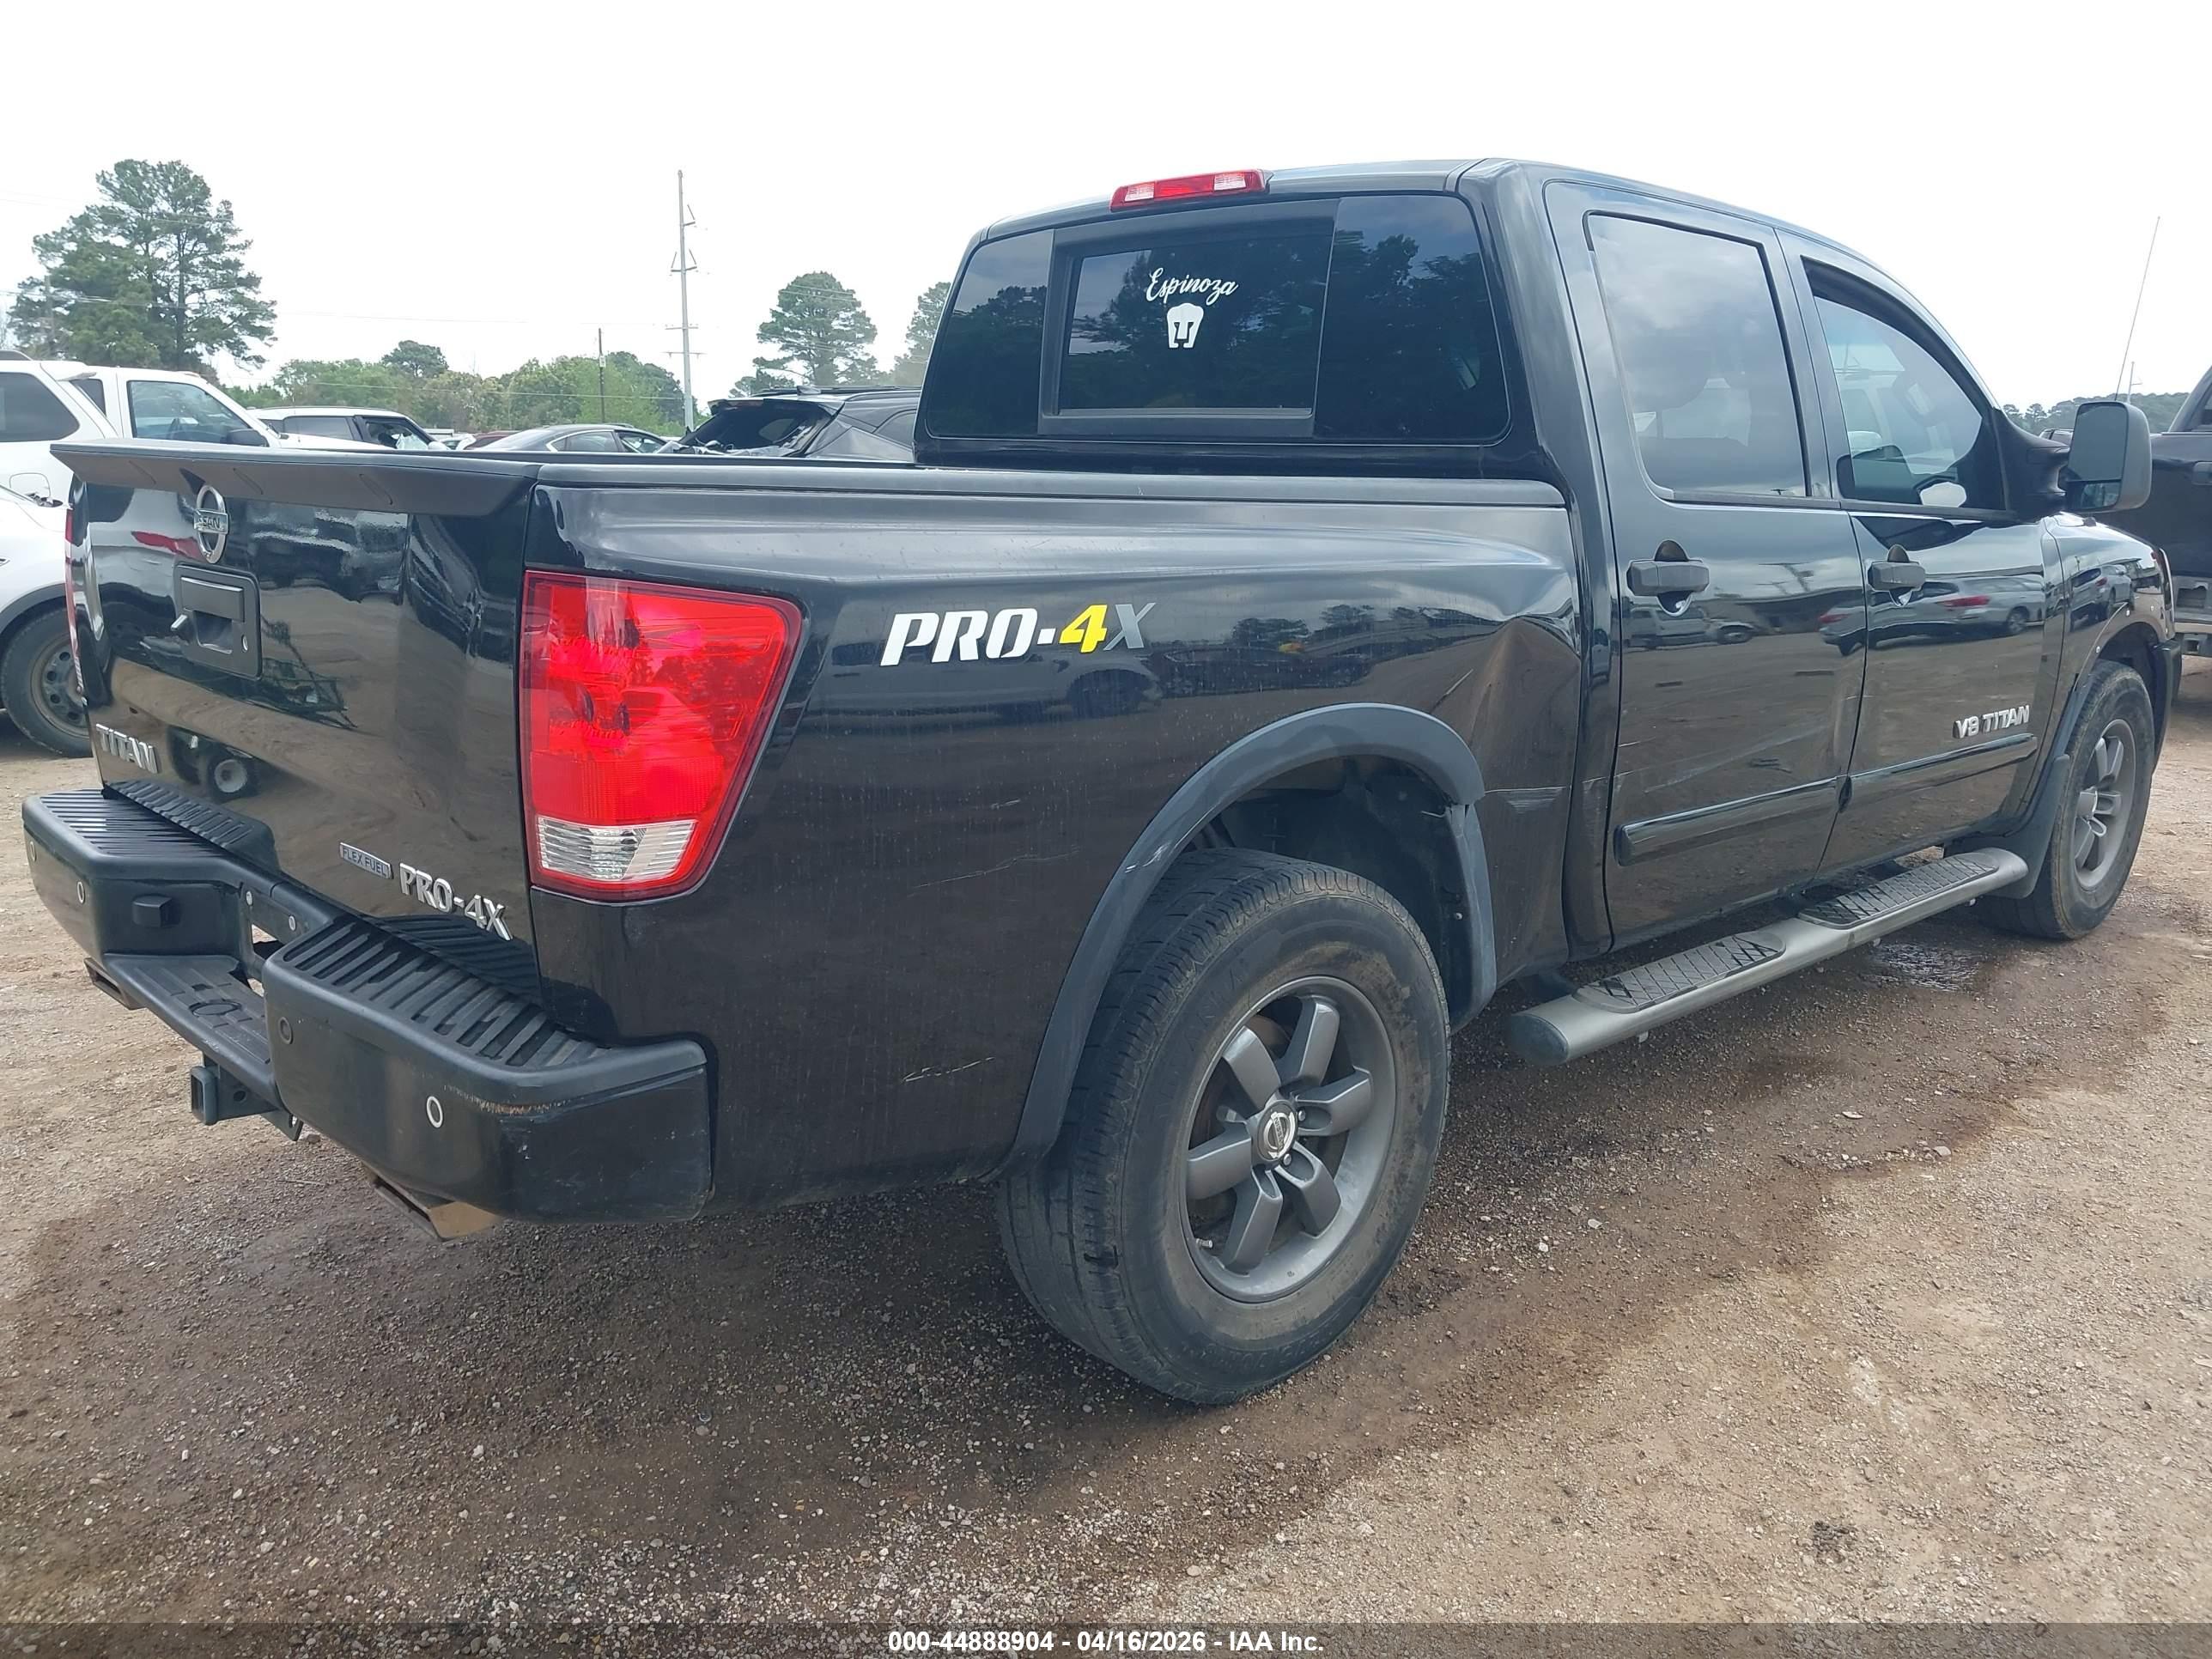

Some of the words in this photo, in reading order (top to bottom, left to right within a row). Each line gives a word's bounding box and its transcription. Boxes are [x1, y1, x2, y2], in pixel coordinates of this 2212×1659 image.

[1146, 267, 1239, 306] Espinoza
[879, 602, 1156, 666] PRO-4X
[1953, 715, 1979, 738] V8
[1982, 704, 2030, 732] TITAN
[95, 723, 158, 774] TITAN
[343, 848, 364, 866] FLEX
[364, 855, 387, 876] FUEL
[399, 862, 514, 941] PRO-4X
